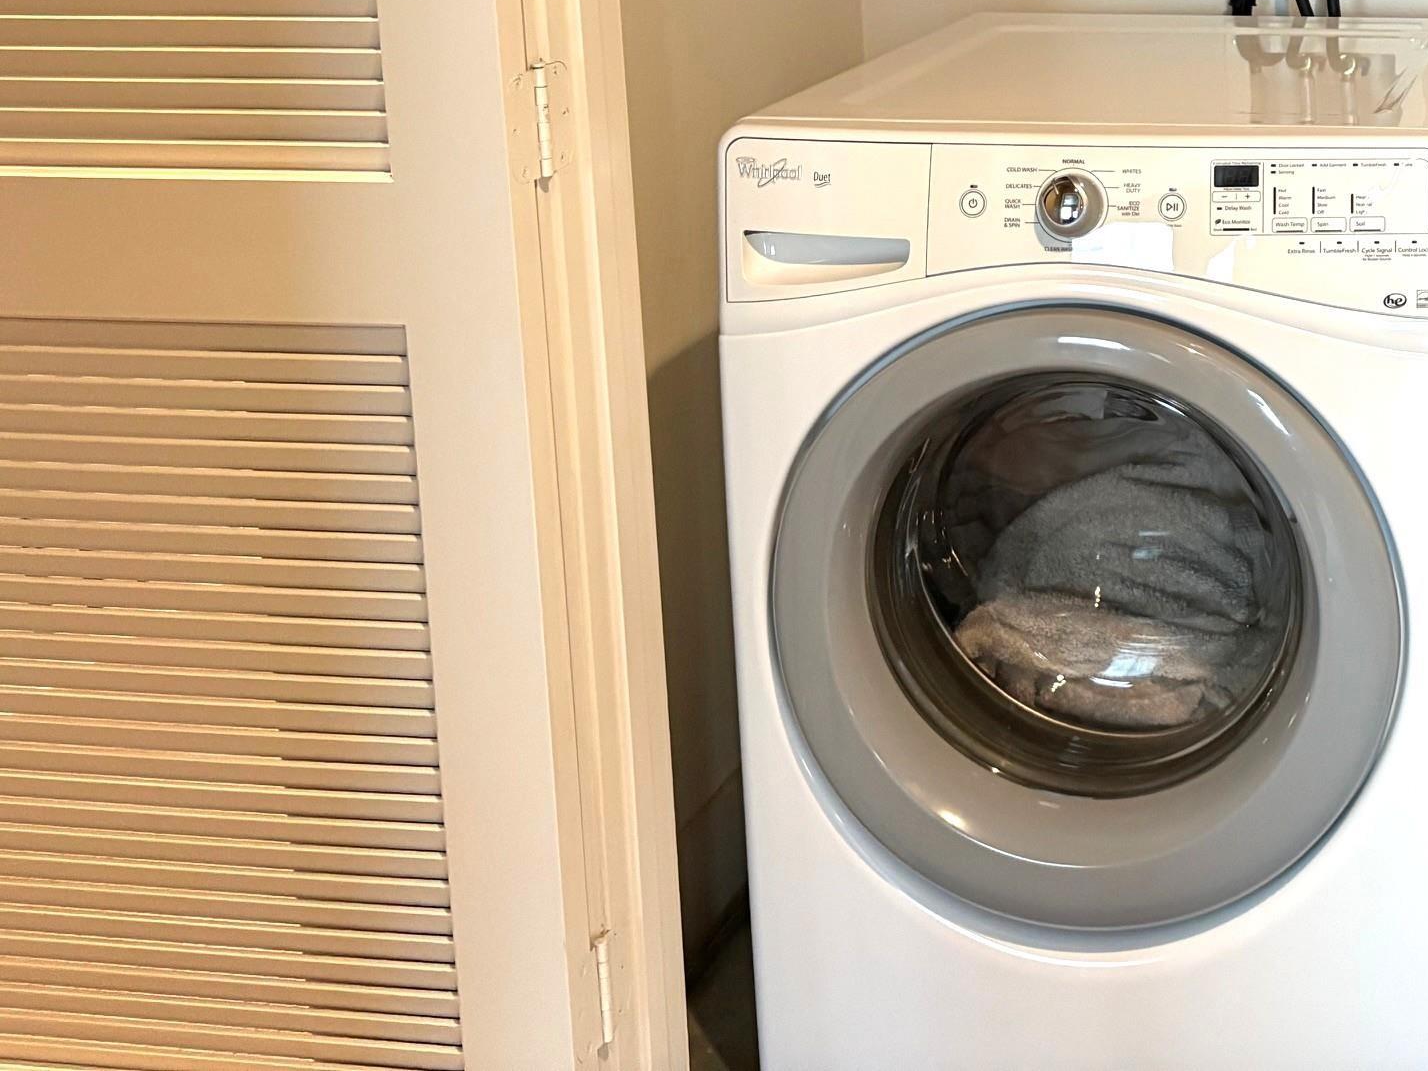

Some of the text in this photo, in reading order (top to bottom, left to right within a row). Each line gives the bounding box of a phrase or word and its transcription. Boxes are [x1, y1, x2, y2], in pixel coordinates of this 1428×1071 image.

[736, 157, 802, 188] Whirlpool
[813, 171, 831, 185] Duet
[1385, 293, 1406, 309] he
